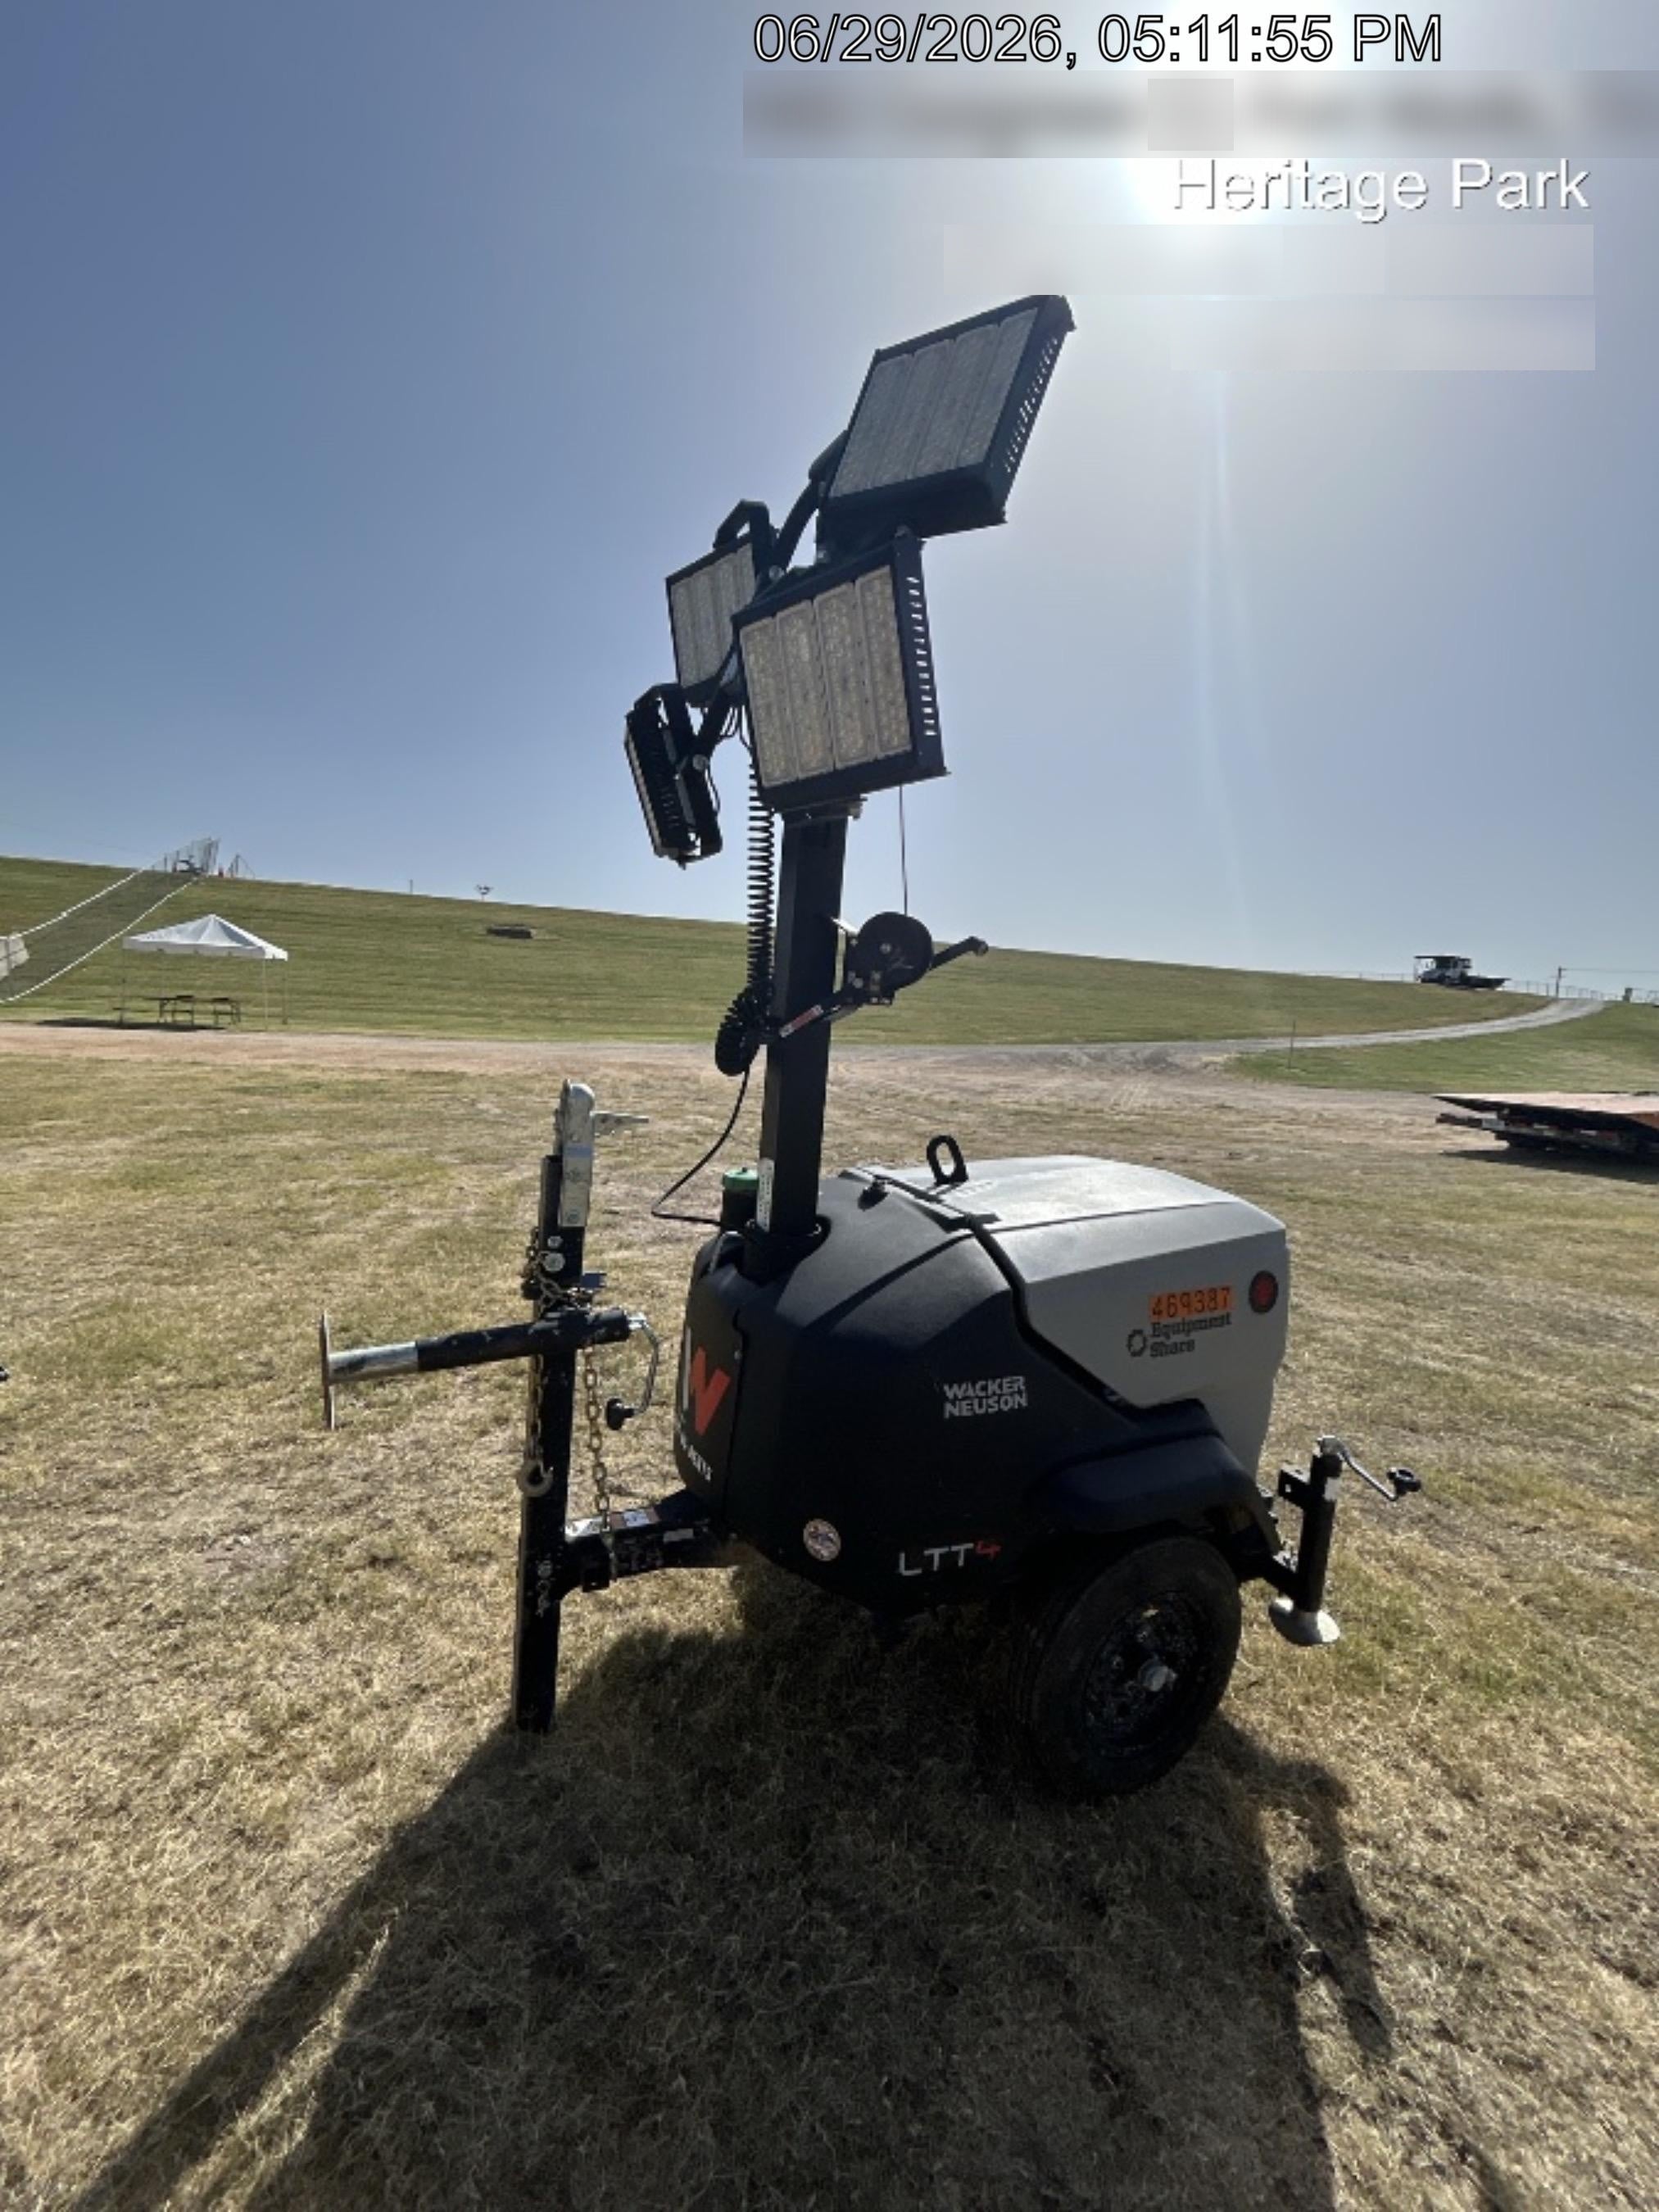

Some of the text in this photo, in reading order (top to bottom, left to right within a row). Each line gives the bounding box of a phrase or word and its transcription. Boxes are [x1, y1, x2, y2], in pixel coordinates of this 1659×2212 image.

[1151, 1286, 1231, 1318] 469387
[1149, 1312, 1232, 1339] Equipment
[1149, 1339, 1195, 1358] Share
[943, 1376, 1026, 1399] WACKER
[943, 1392, 1028, 1419] NEUSON
[899, 1541, 1000, 1576] LTT4
